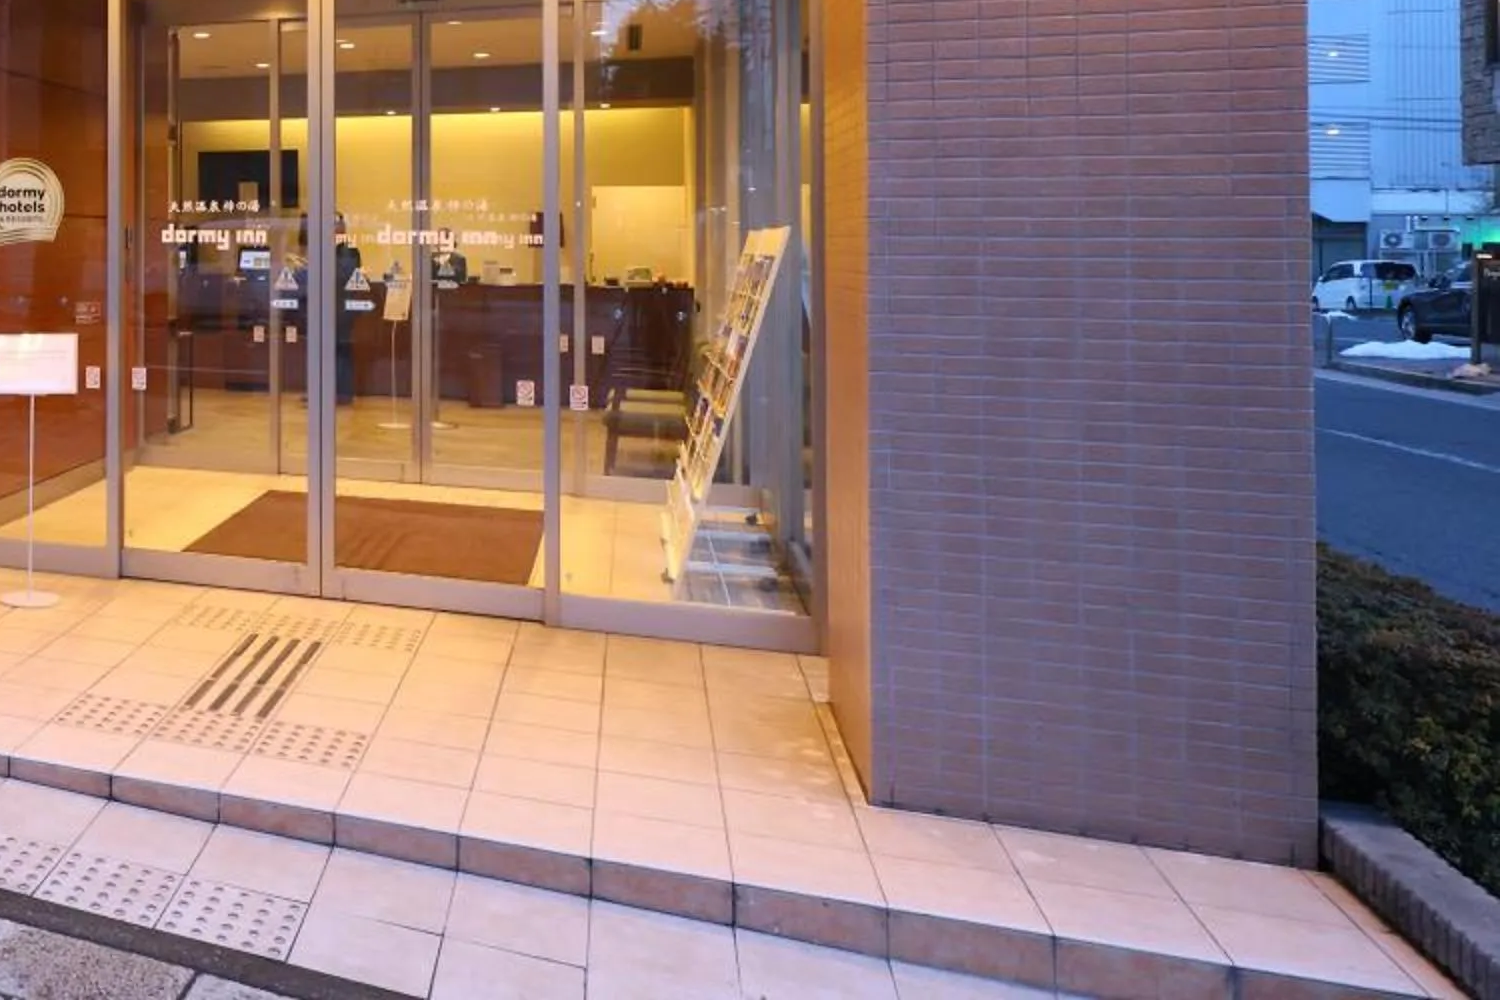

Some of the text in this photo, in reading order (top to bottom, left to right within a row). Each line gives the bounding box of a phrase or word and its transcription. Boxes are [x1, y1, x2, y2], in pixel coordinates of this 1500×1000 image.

[161, 223, 267, 251] dormy inn
[377, 222, 455, 252] dormy
